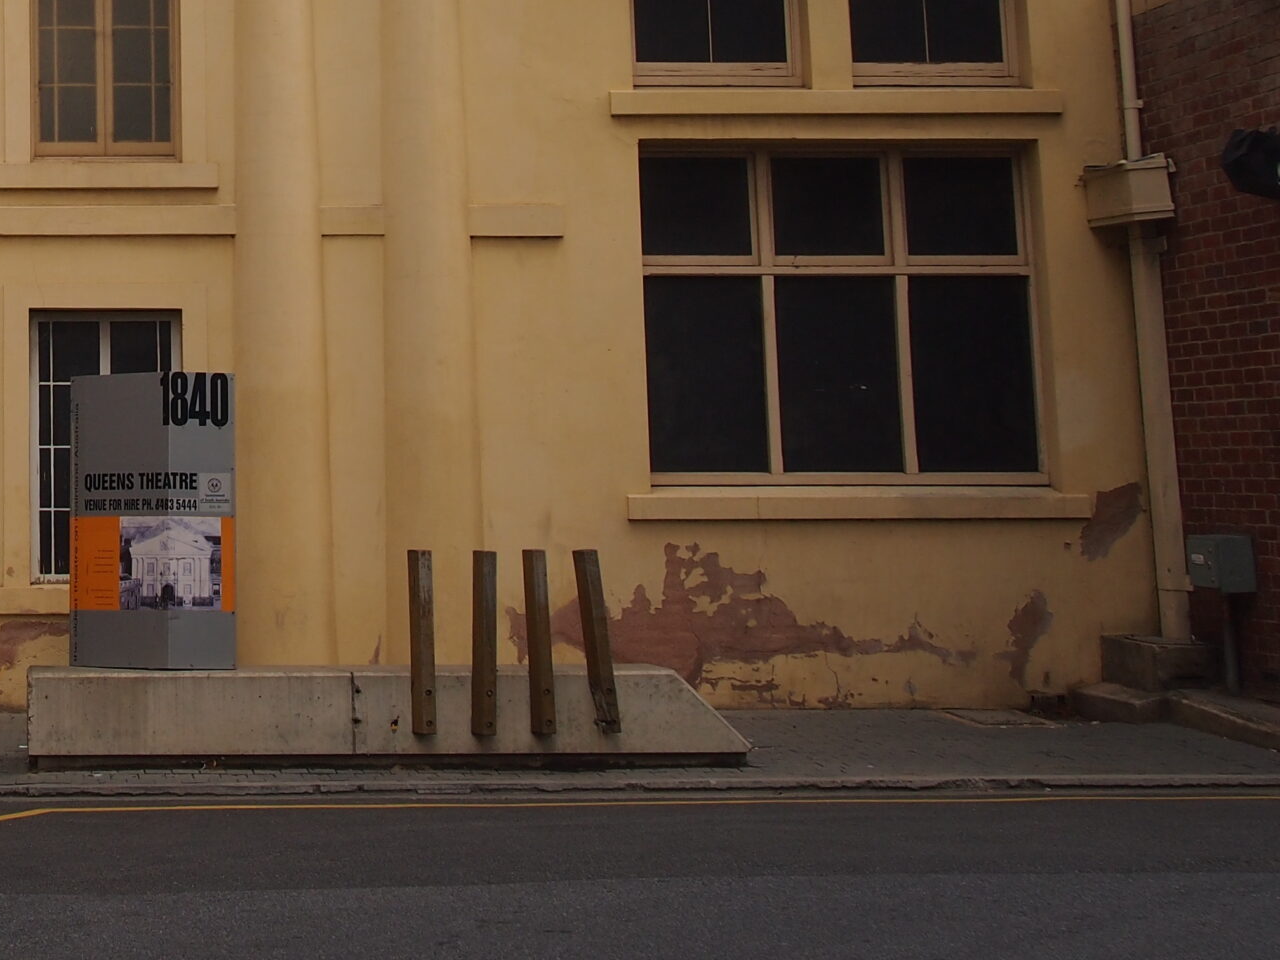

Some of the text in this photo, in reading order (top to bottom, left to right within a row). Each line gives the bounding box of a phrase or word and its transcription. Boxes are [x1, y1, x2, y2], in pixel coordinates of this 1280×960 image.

[160, 371, 229, 428] 1840
[84, 472, 198, 492] QUEENS THEATRE
[84, 498, 107, 511] VENUE
[109, 498, 122, 511] FOR
[123, 497, 140, 511] HIRE
[142, 498, 154, 511] PH.
[176, 498, 197, 511] 5444
